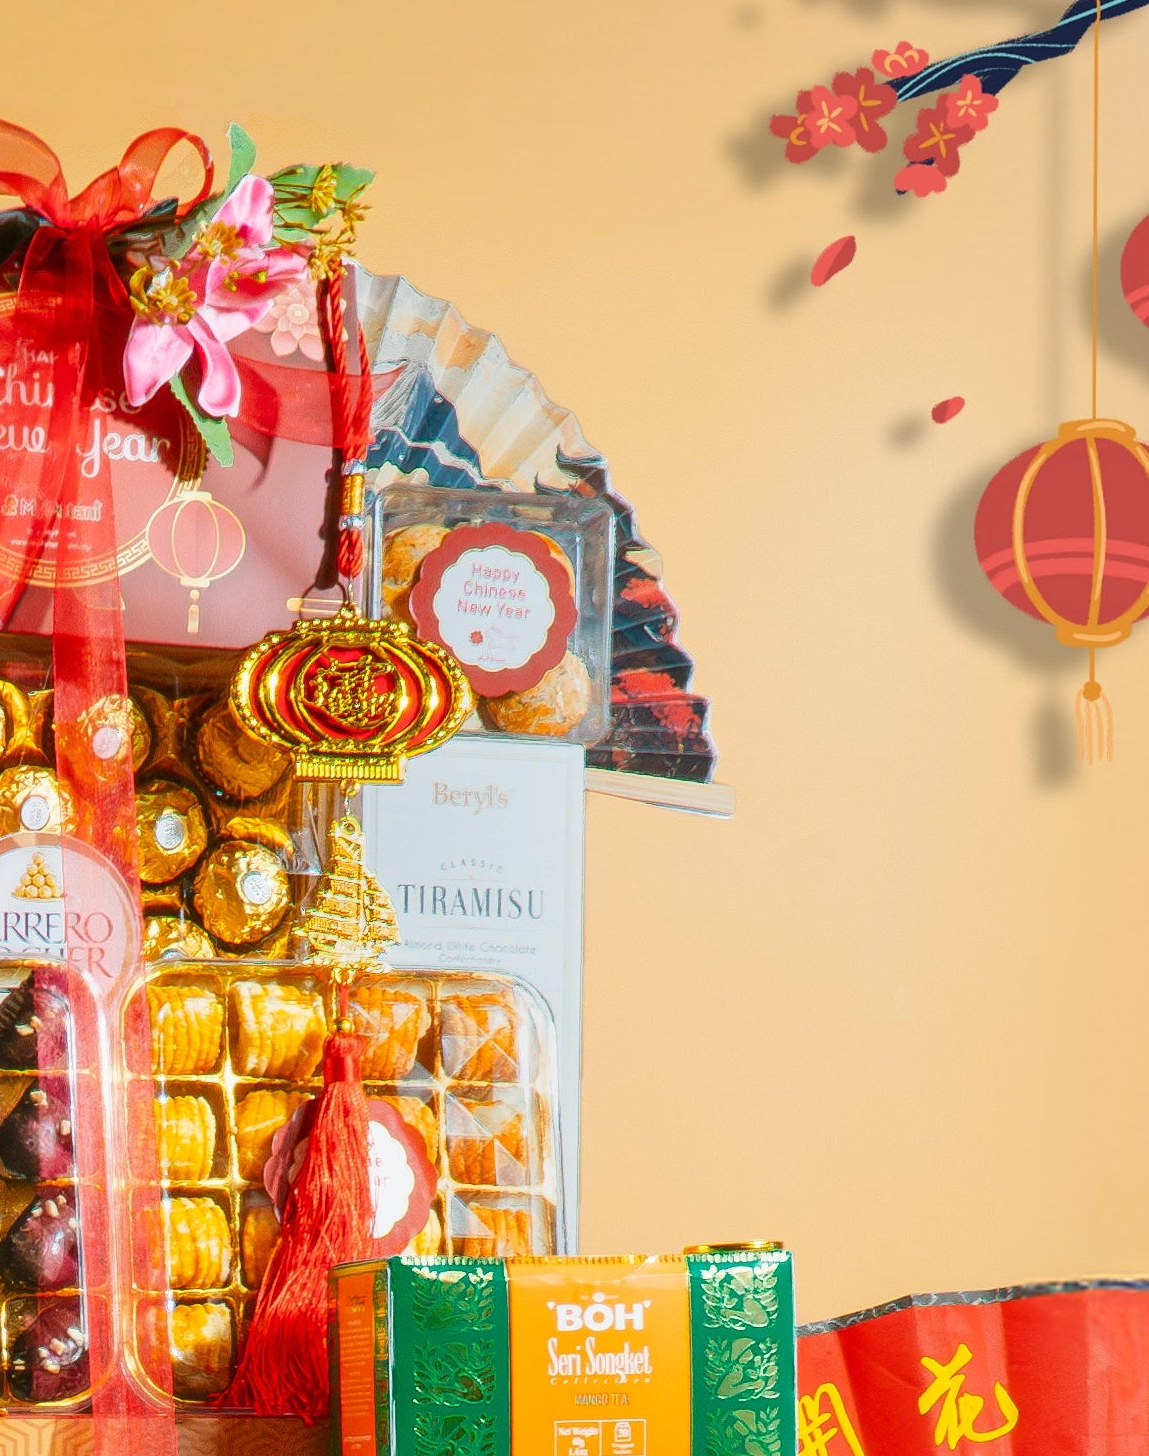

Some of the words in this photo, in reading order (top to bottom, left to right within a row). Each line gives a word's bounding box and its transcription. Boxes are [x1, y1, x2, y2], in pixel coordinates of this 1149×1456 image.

[471, 562, 520, 582] Happy
[463, 581, 527, 600] Chinese
[457, 599, 492, 616] New
[497, 602, 532, 619] Year
[434, 781, 510, 815] Beryl's
[439, 857, 505, 873] CLASSIC
[397, 884, 545, 920] TIRAMISU
[547, 1337, 582, 1377] Seri
[585, 1336, 653, 1384] Songket
